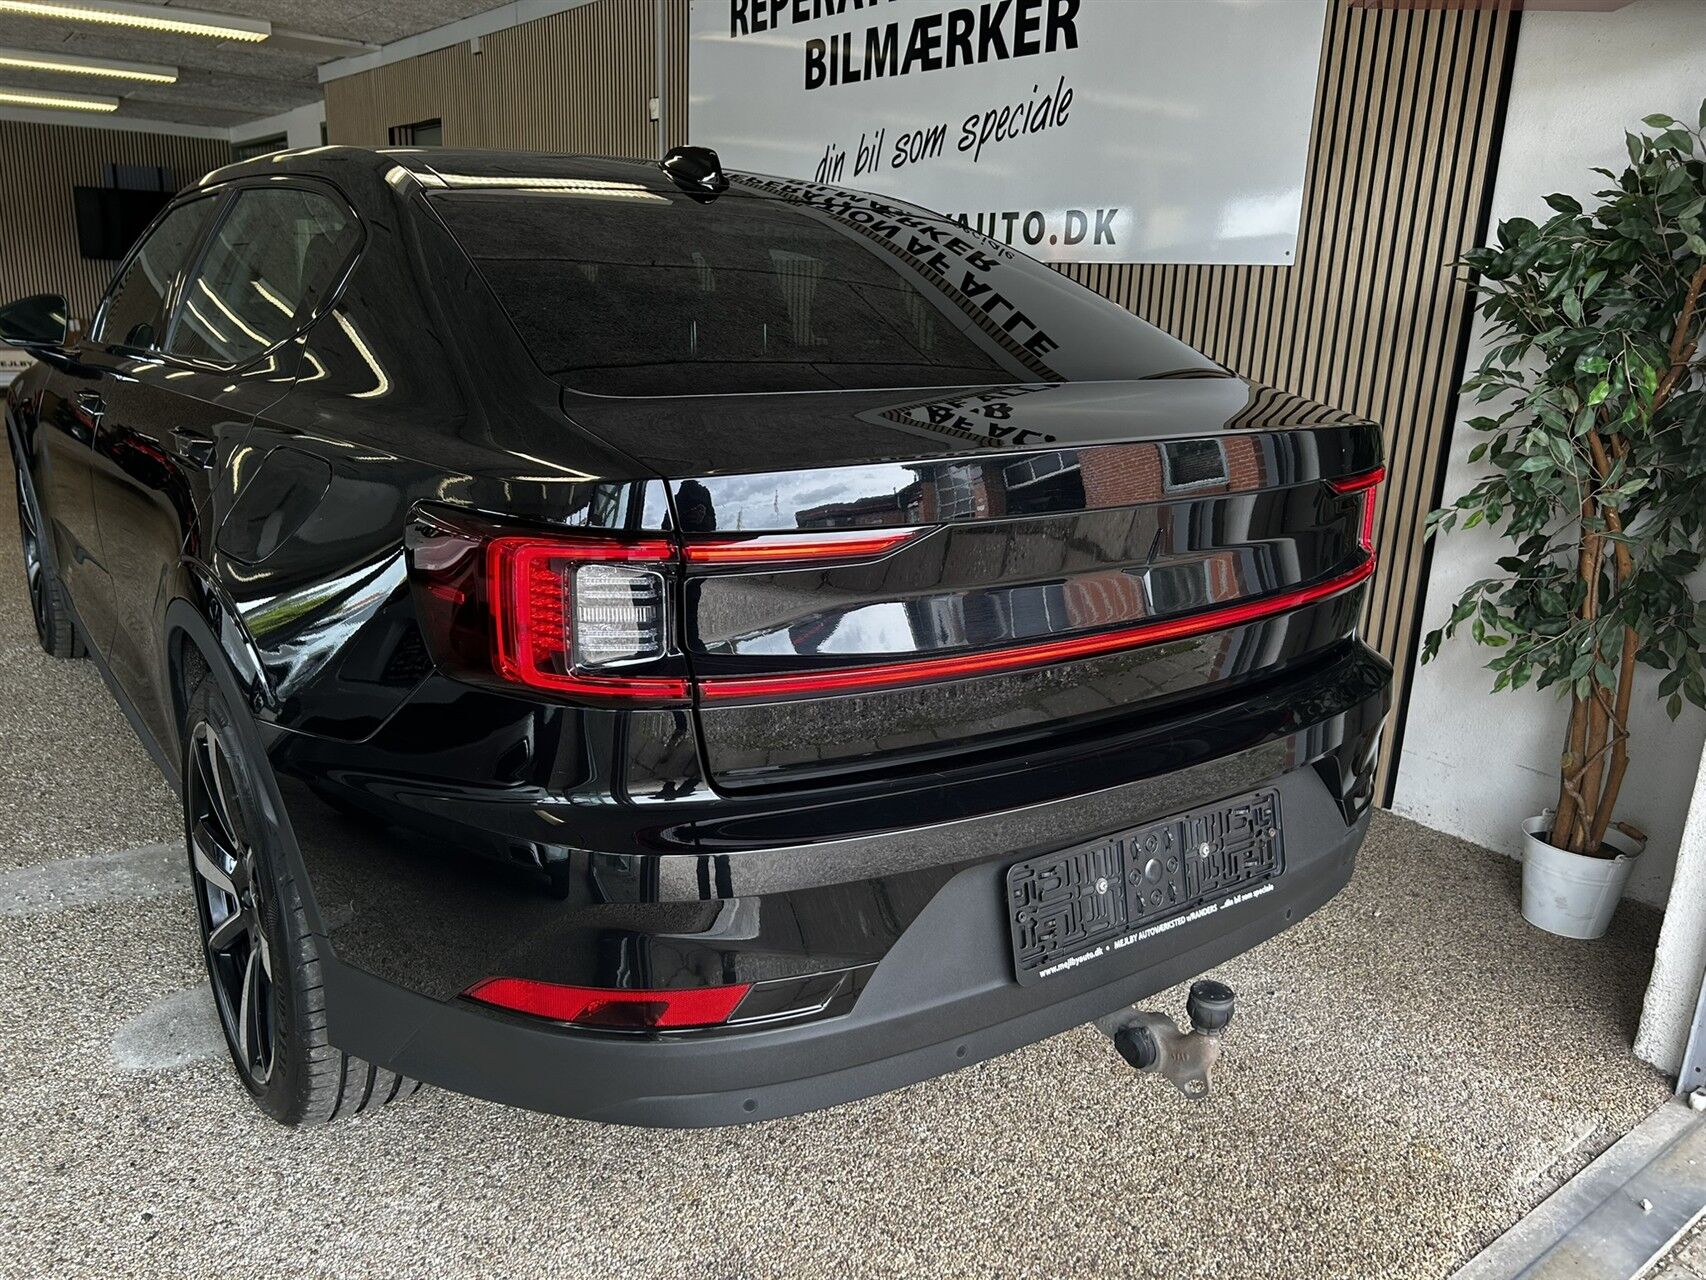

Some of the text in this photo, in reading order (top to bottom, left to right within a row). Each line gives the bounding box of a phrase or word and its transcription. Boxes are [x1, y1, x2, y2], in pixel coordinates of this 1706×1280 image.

[731, 0, 898, 38] REPE
[805, 0, 1080, 90] BILMÆRKER
[815, 75, 1074, 184] din bil som speciale
[946, 209, 1119, 246] UTO.DK
